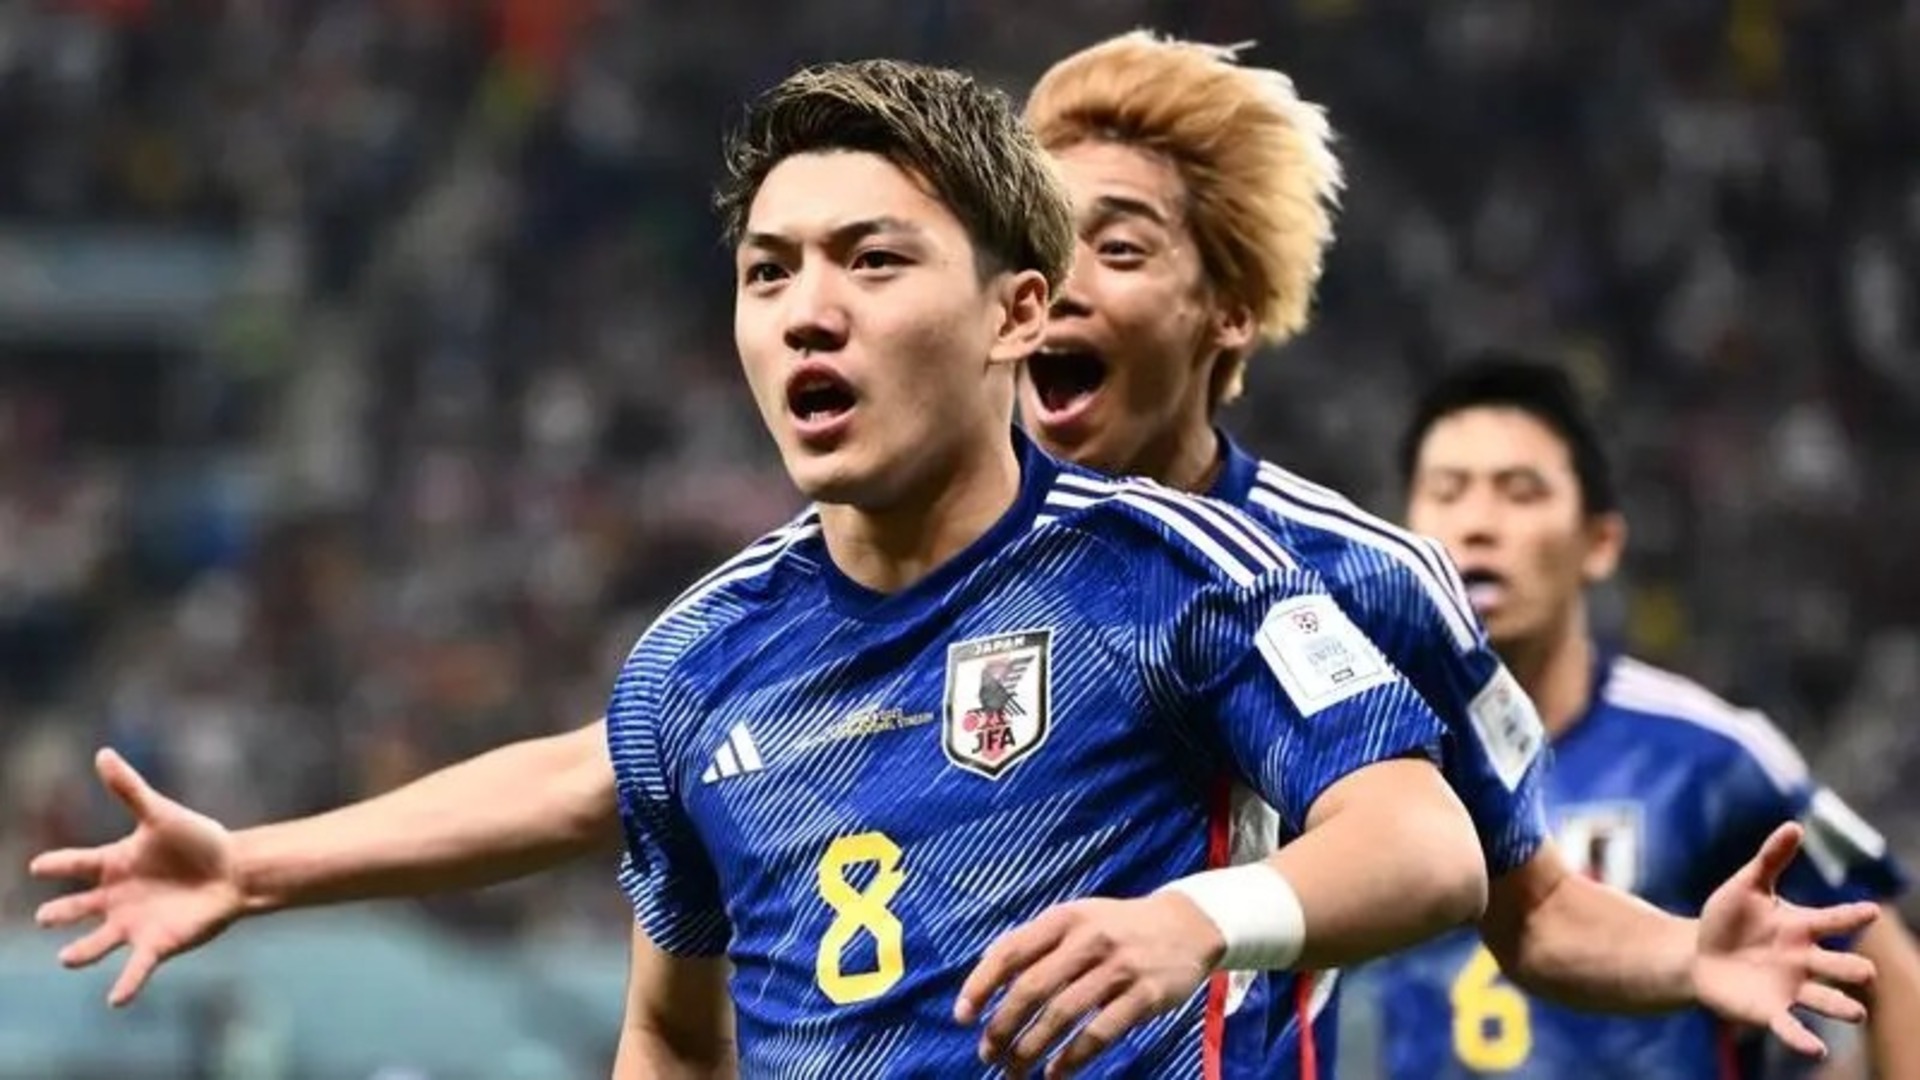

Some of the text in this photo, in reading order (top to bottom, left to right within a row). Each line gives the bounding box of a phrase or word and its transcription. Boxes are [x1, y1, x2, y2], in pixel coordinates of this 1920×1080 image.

[975, 635, 1026, 656] JAPAN
[971, 726, 1016, 754] JFA
[816, 831, 906, 1005] 8
[1451, 941, 1531, 1071] 6
